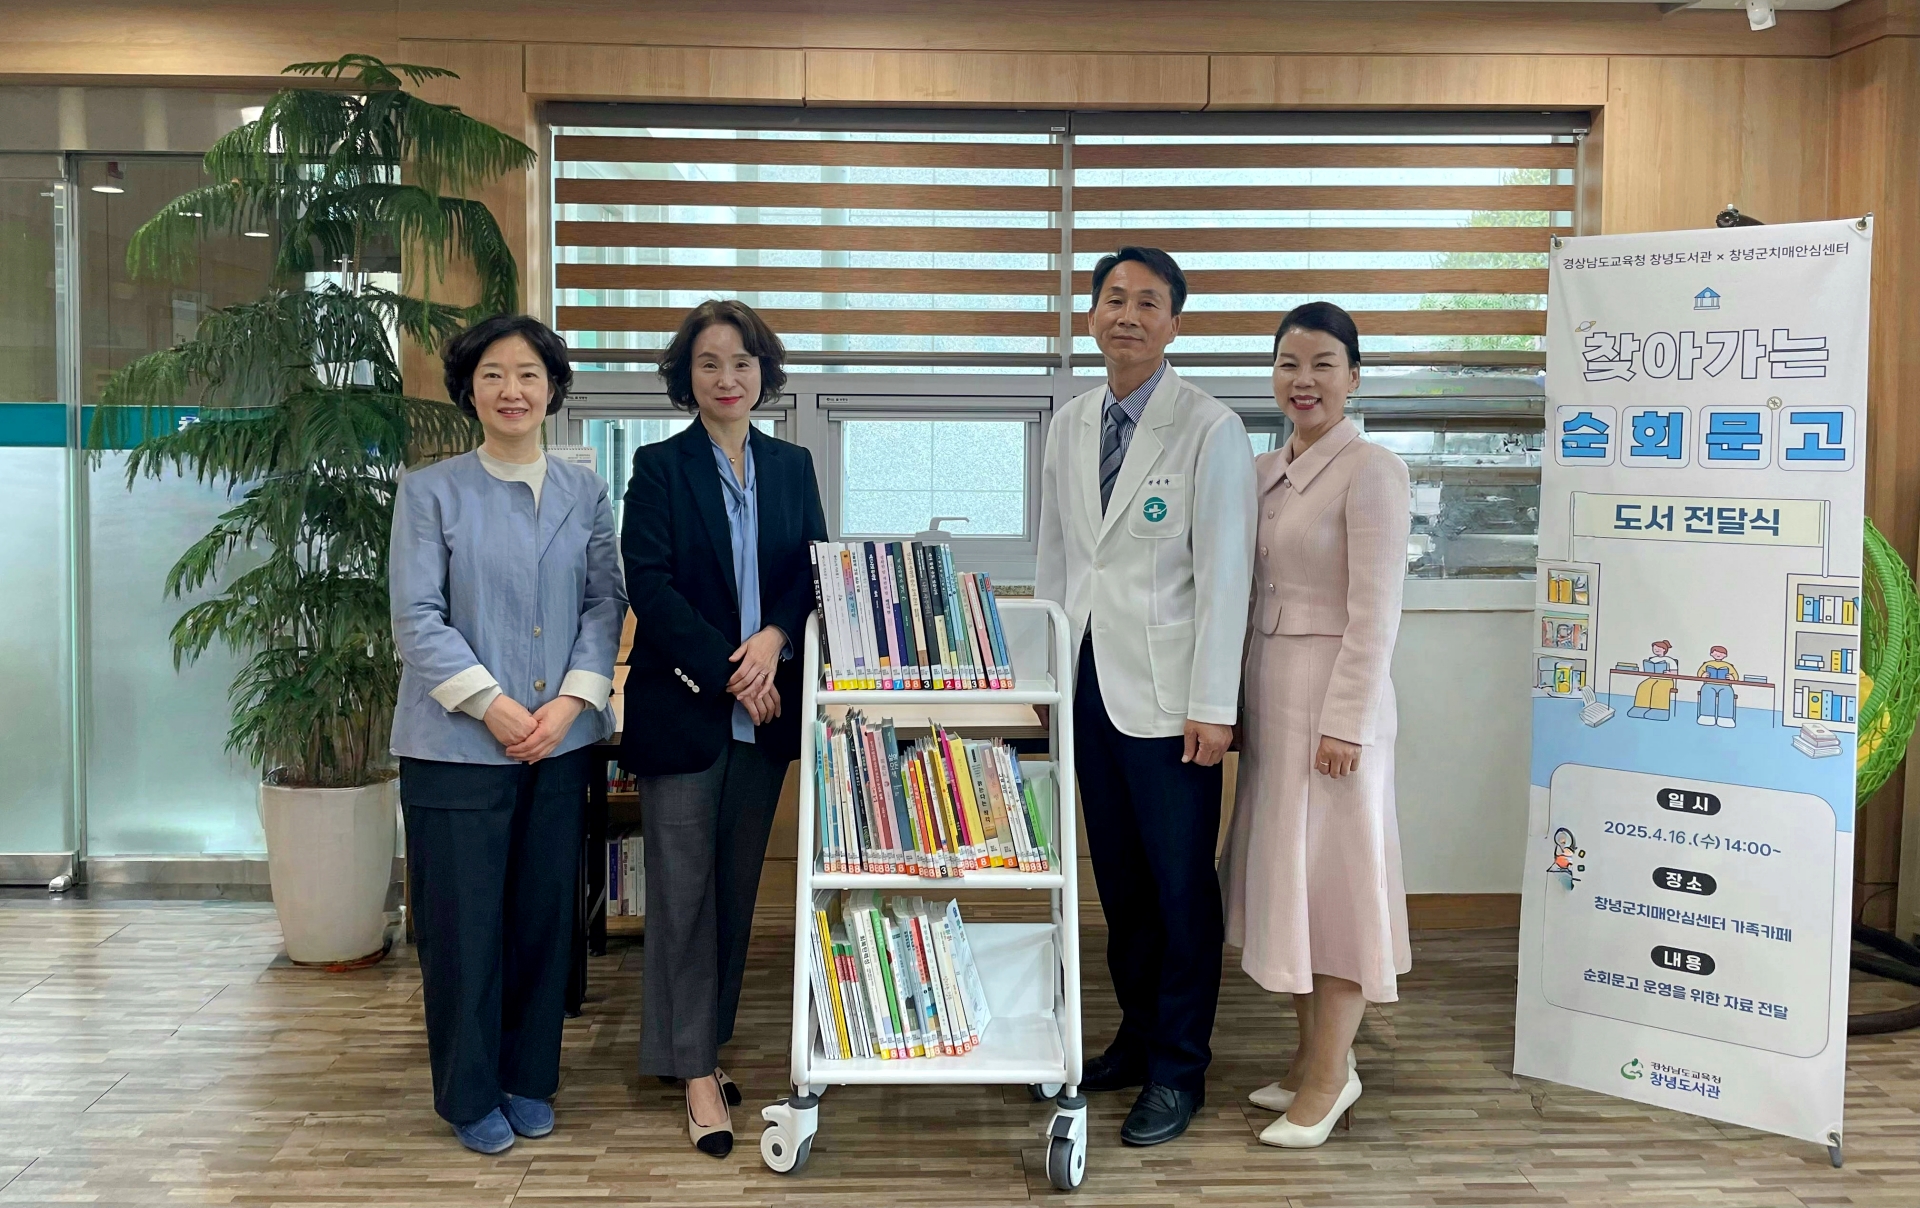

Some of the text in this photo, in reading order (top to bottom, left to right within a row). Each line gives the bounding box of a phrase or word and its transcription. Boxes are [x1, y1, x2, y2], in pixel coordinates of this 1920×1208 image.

[1563, 254, 1645, 270] 경상남도교육청
[1649, 250, 1712, 266] 창녕도서관
[1729, 241, 1849, 262] 창녕군치매안심센터
[1582, 328, 1830, 382] 찾아가는
[1613, 503, 1780, 537] 도서 전달식
[979, 680, 985, 688] 8
[991, 680, 997, 688] 6
[1001, 680, 1006, 688] 8
[1724, 837, 1782, 857] 14:00~
[980, 857, 987, 866] 8
[1008, 858, 1013, 866] 8
[824, 864, 830, 872] 8
[841, 864, 847, 872] 8
[849, 865, 854, 873] 8
[855, 865, 860, 873] 8
[869, 864, 874, 872] 8
[879, 865, 884, 873] 8
[884, 864, 890, 872] 8
[890, 864, 895, 872] 5
[898, 864, 904, 872] 8
[941, 867, 946, 875] 3
[1031, 863, 1036, 871] 8
[1036, 863, 1042, 871] 8
[929, 869, 935, 877] 8
[1594, 895, 1792, 943] 창녕군치매안심센터 가족카페
[1583, 968, 1789, 1021] 순회문고 운영을 위한 자료 전달
[971, 1036, 978, 1044] 8
[935, 1046, 940, 1054] 8
[946, 1046, 952, 1054] 8
[964, 1042, 971, 1051] 8
[891, 1049, 897, 1057] 8
[900, 1049, 906, 1057] 6
[957, 1047, 963, 1055] 8
[1649, 1071, 1721, 1100] 창녕도서관
